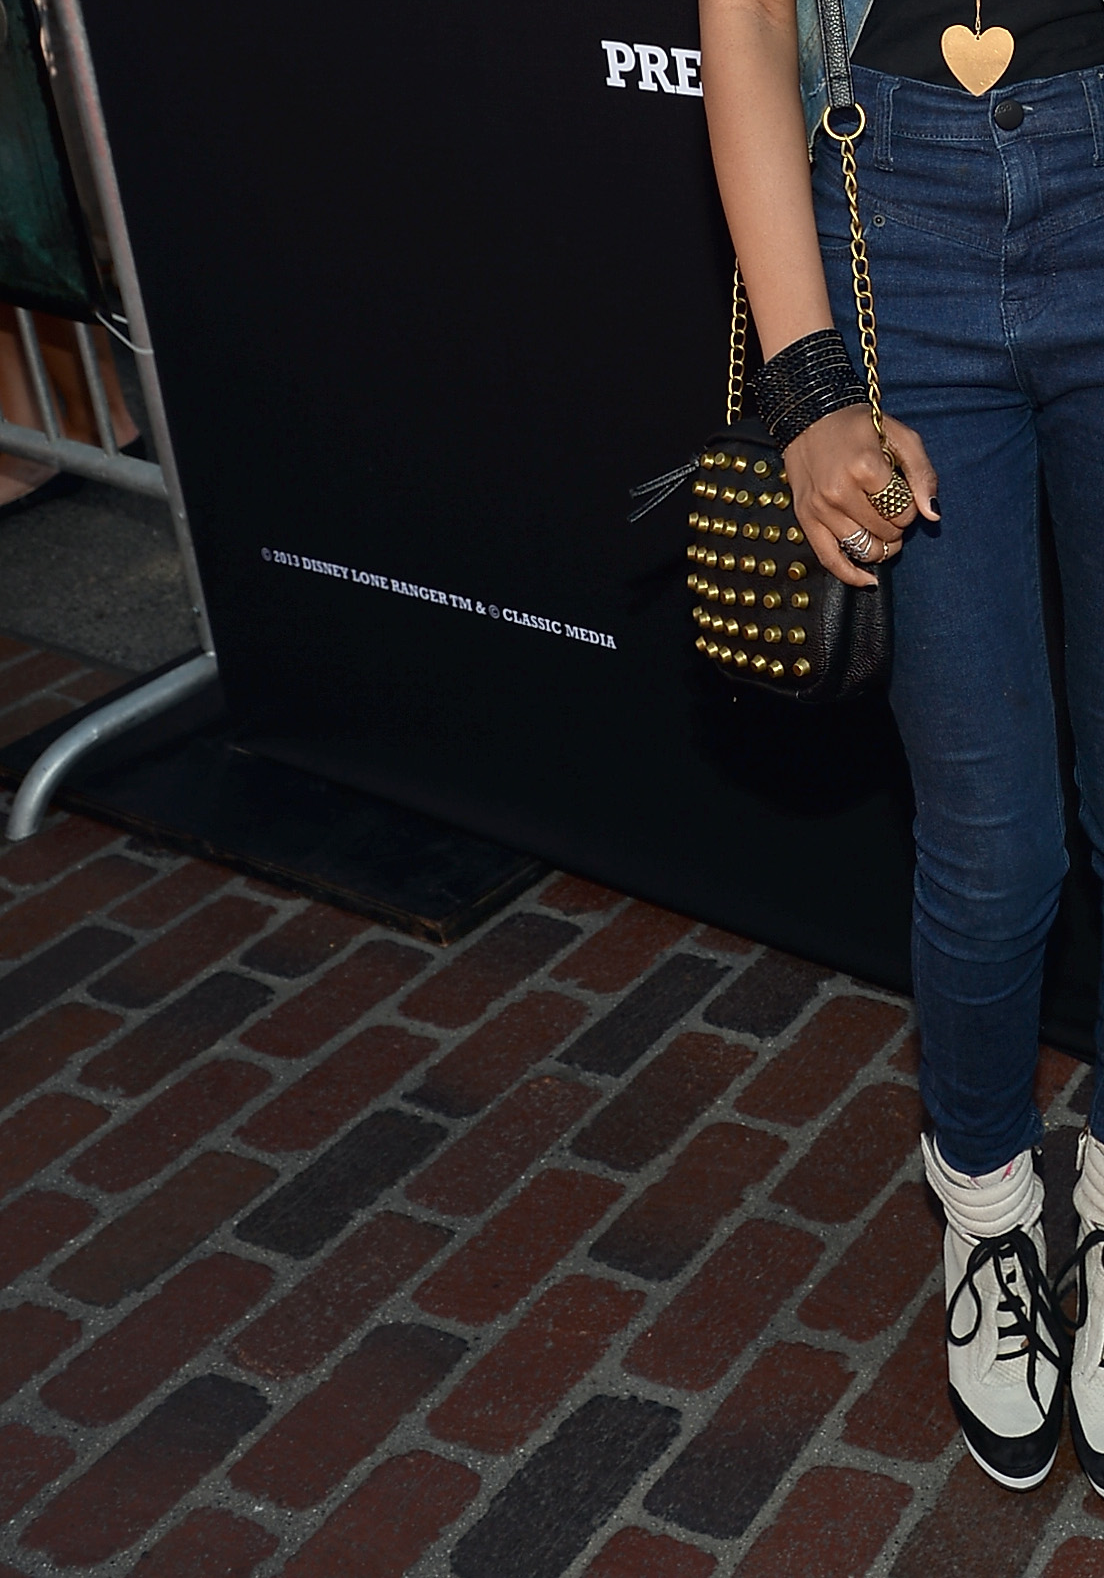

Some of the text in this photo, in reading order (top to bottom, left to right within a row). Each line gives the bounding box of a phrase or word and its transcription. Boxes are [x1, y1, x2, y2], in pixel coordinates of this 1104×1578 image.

[273, 550, 300, 568] 2013
[301, 556, 350, 580] DISNEY
[351, 569, 390, 591] LONE
[391, 578, 449, 606] RANGER
[449, 594, 473, 612] TM
[475, 601, 487, 616] &
[502, 608, 563, 635] CLASSIC
[564, 624, 618, 651] MEDIA
